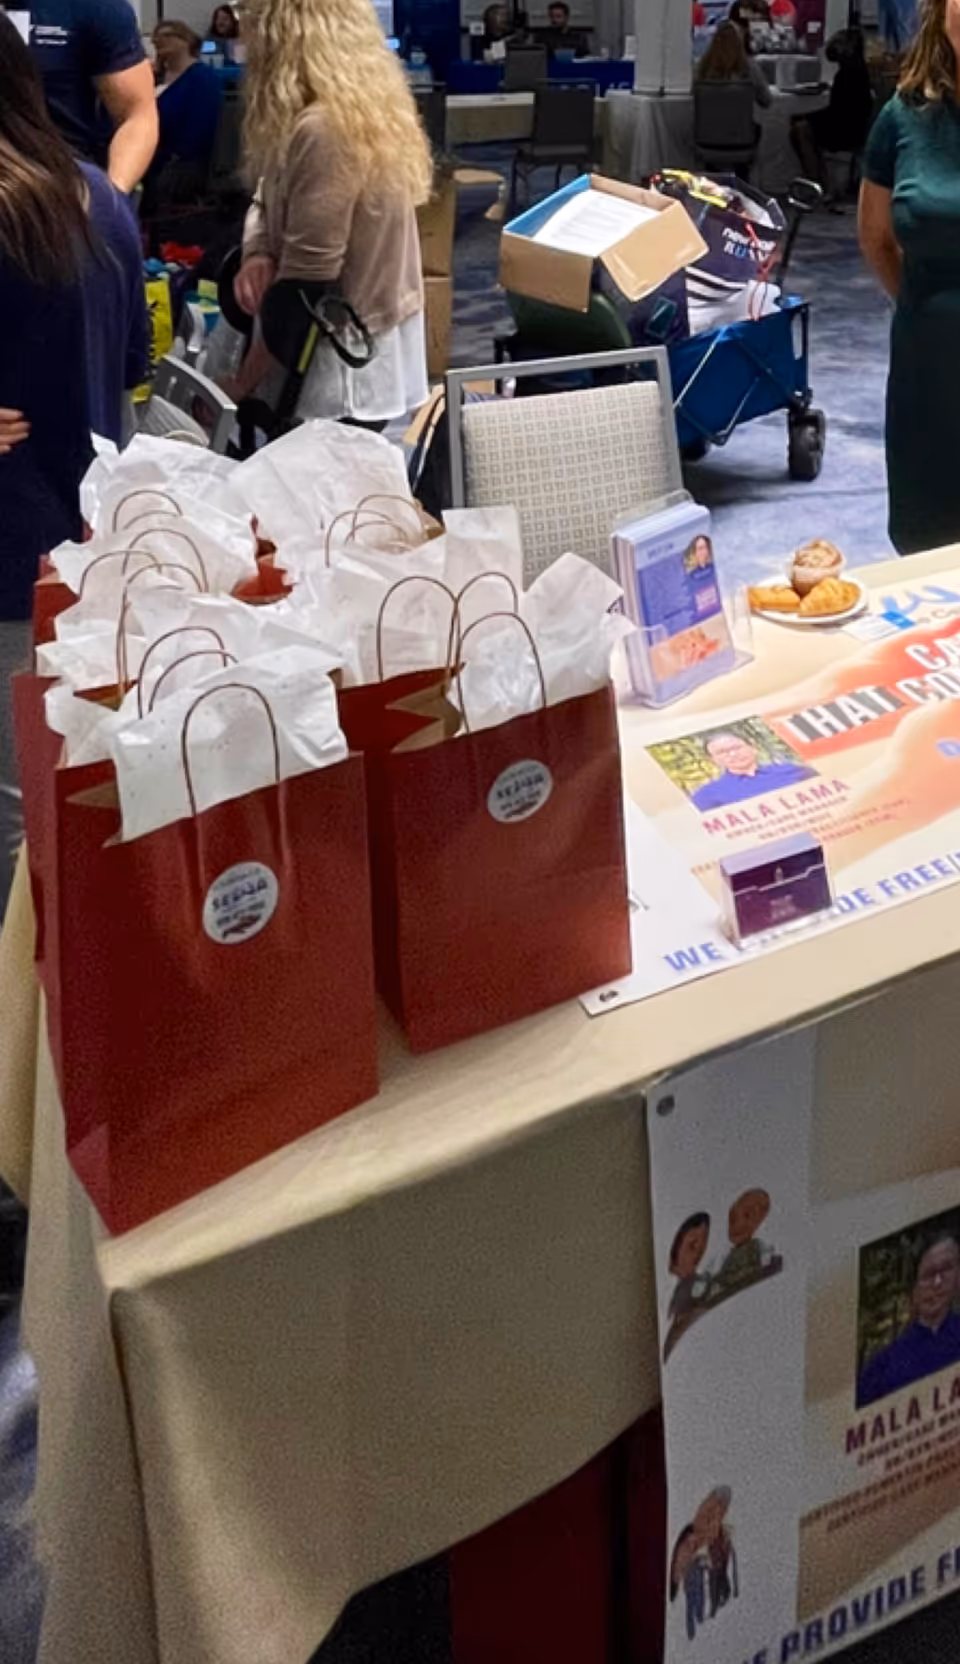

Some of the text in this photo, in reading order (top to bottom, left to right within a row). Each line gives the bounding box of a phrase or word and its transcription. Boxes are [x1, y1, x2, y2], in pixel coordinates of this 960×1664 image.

[782, 684, 900, 744] THAT
[702, 802, 775, 834] MALA
[778, 779, 850, 810] LAMA
[663, 941, 722, 972] WE
[845, 1395, 922, 1455] MALA
[780, 1566, 927, 1664] PROVIDE
